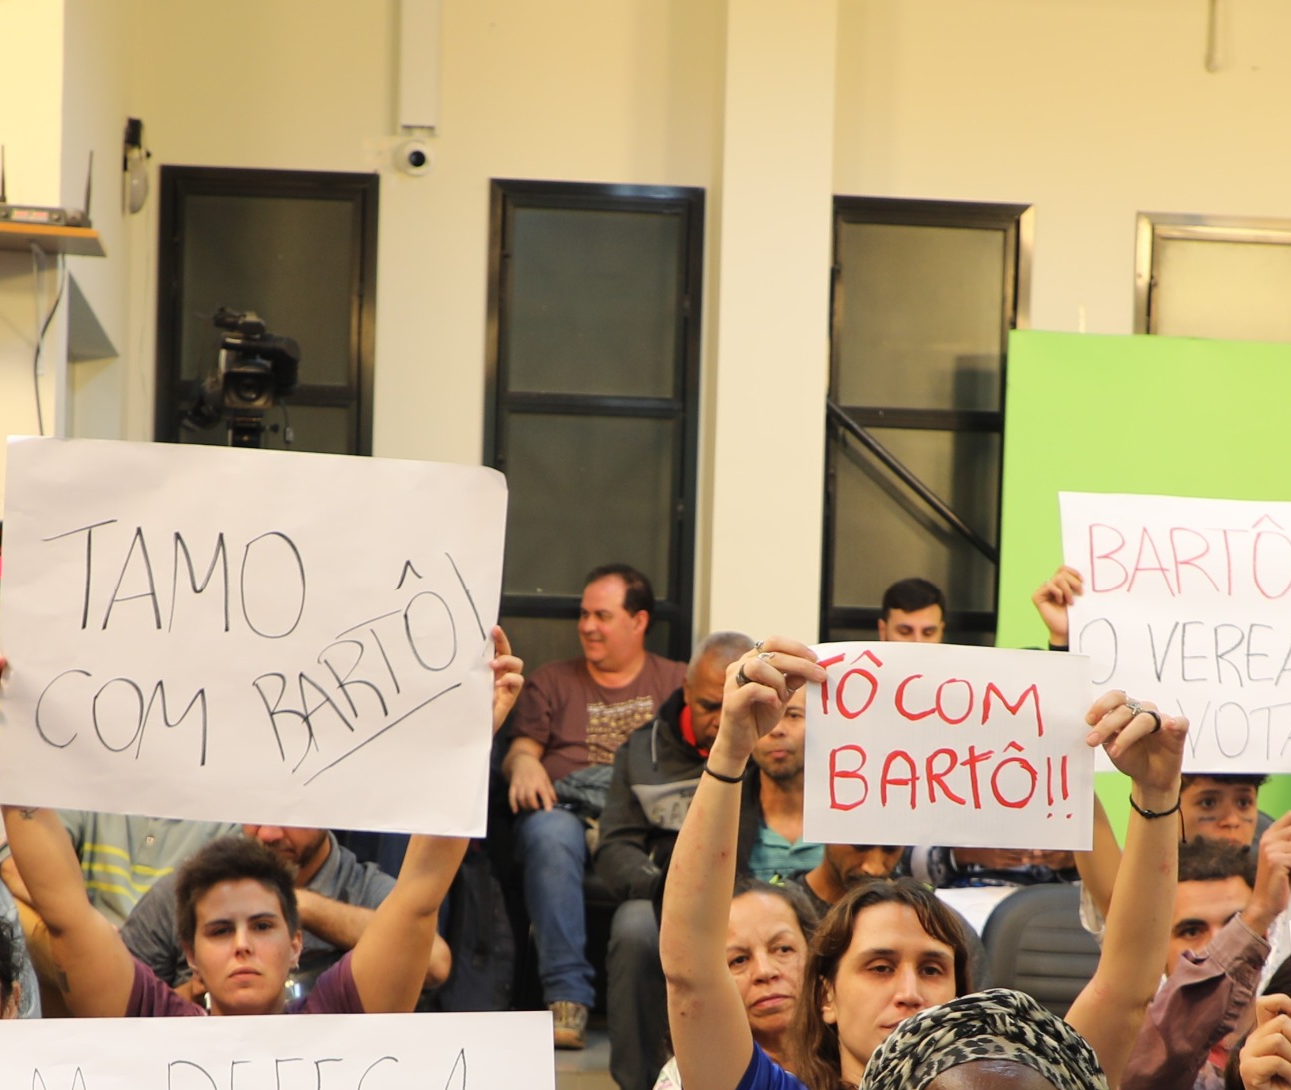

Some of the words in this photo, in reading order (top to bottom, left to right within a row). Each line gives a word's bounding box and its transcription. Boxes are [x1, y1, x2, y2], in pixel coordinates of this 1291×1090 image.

[41, 519, 306, 639] TAMO
[816, 650, 883, 720] TÔ
[894, 672, 1045, 738] COM
[1077, 616, 1119, 685] O
[35, 669, 208, 767] COM
[828, 739, 1075, 820] BARTÔ!!
